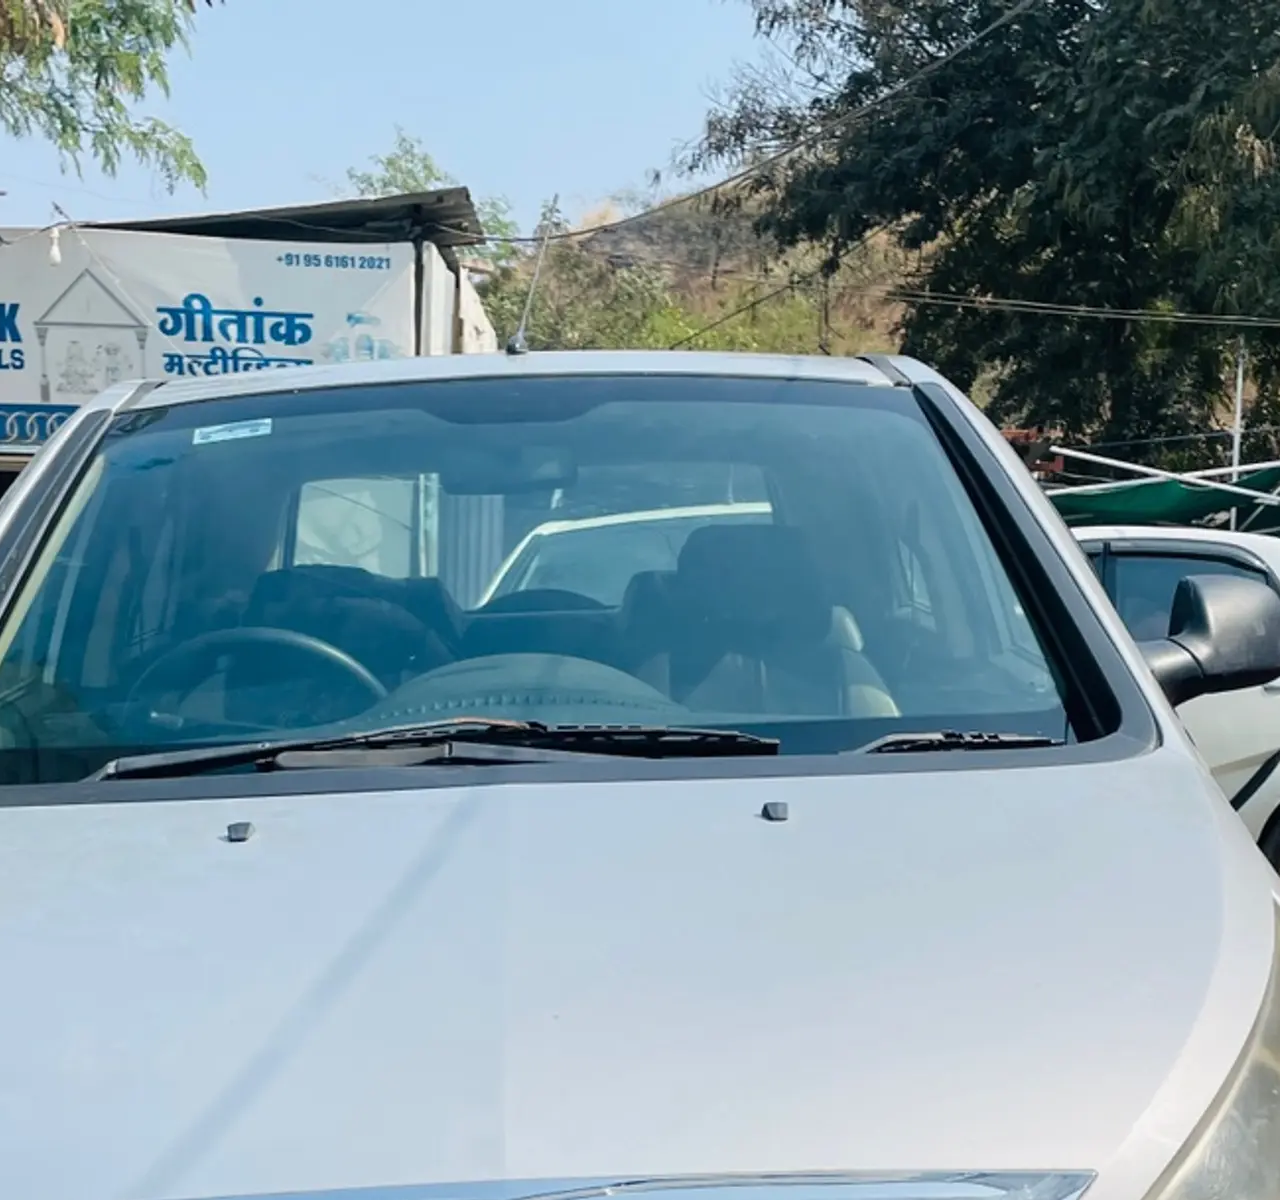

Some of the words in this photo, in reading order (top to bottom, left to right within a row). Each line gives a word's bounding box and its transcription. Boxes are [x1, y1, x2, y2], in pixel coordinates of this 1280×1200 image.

[276, 252, 300, 266] +91
[303, 253, 321, 267] 95
[324, 254, 356, 269] 6161
[358, 256, 391, 270] 2021
[156, 293, 314, 346] गीतांक
